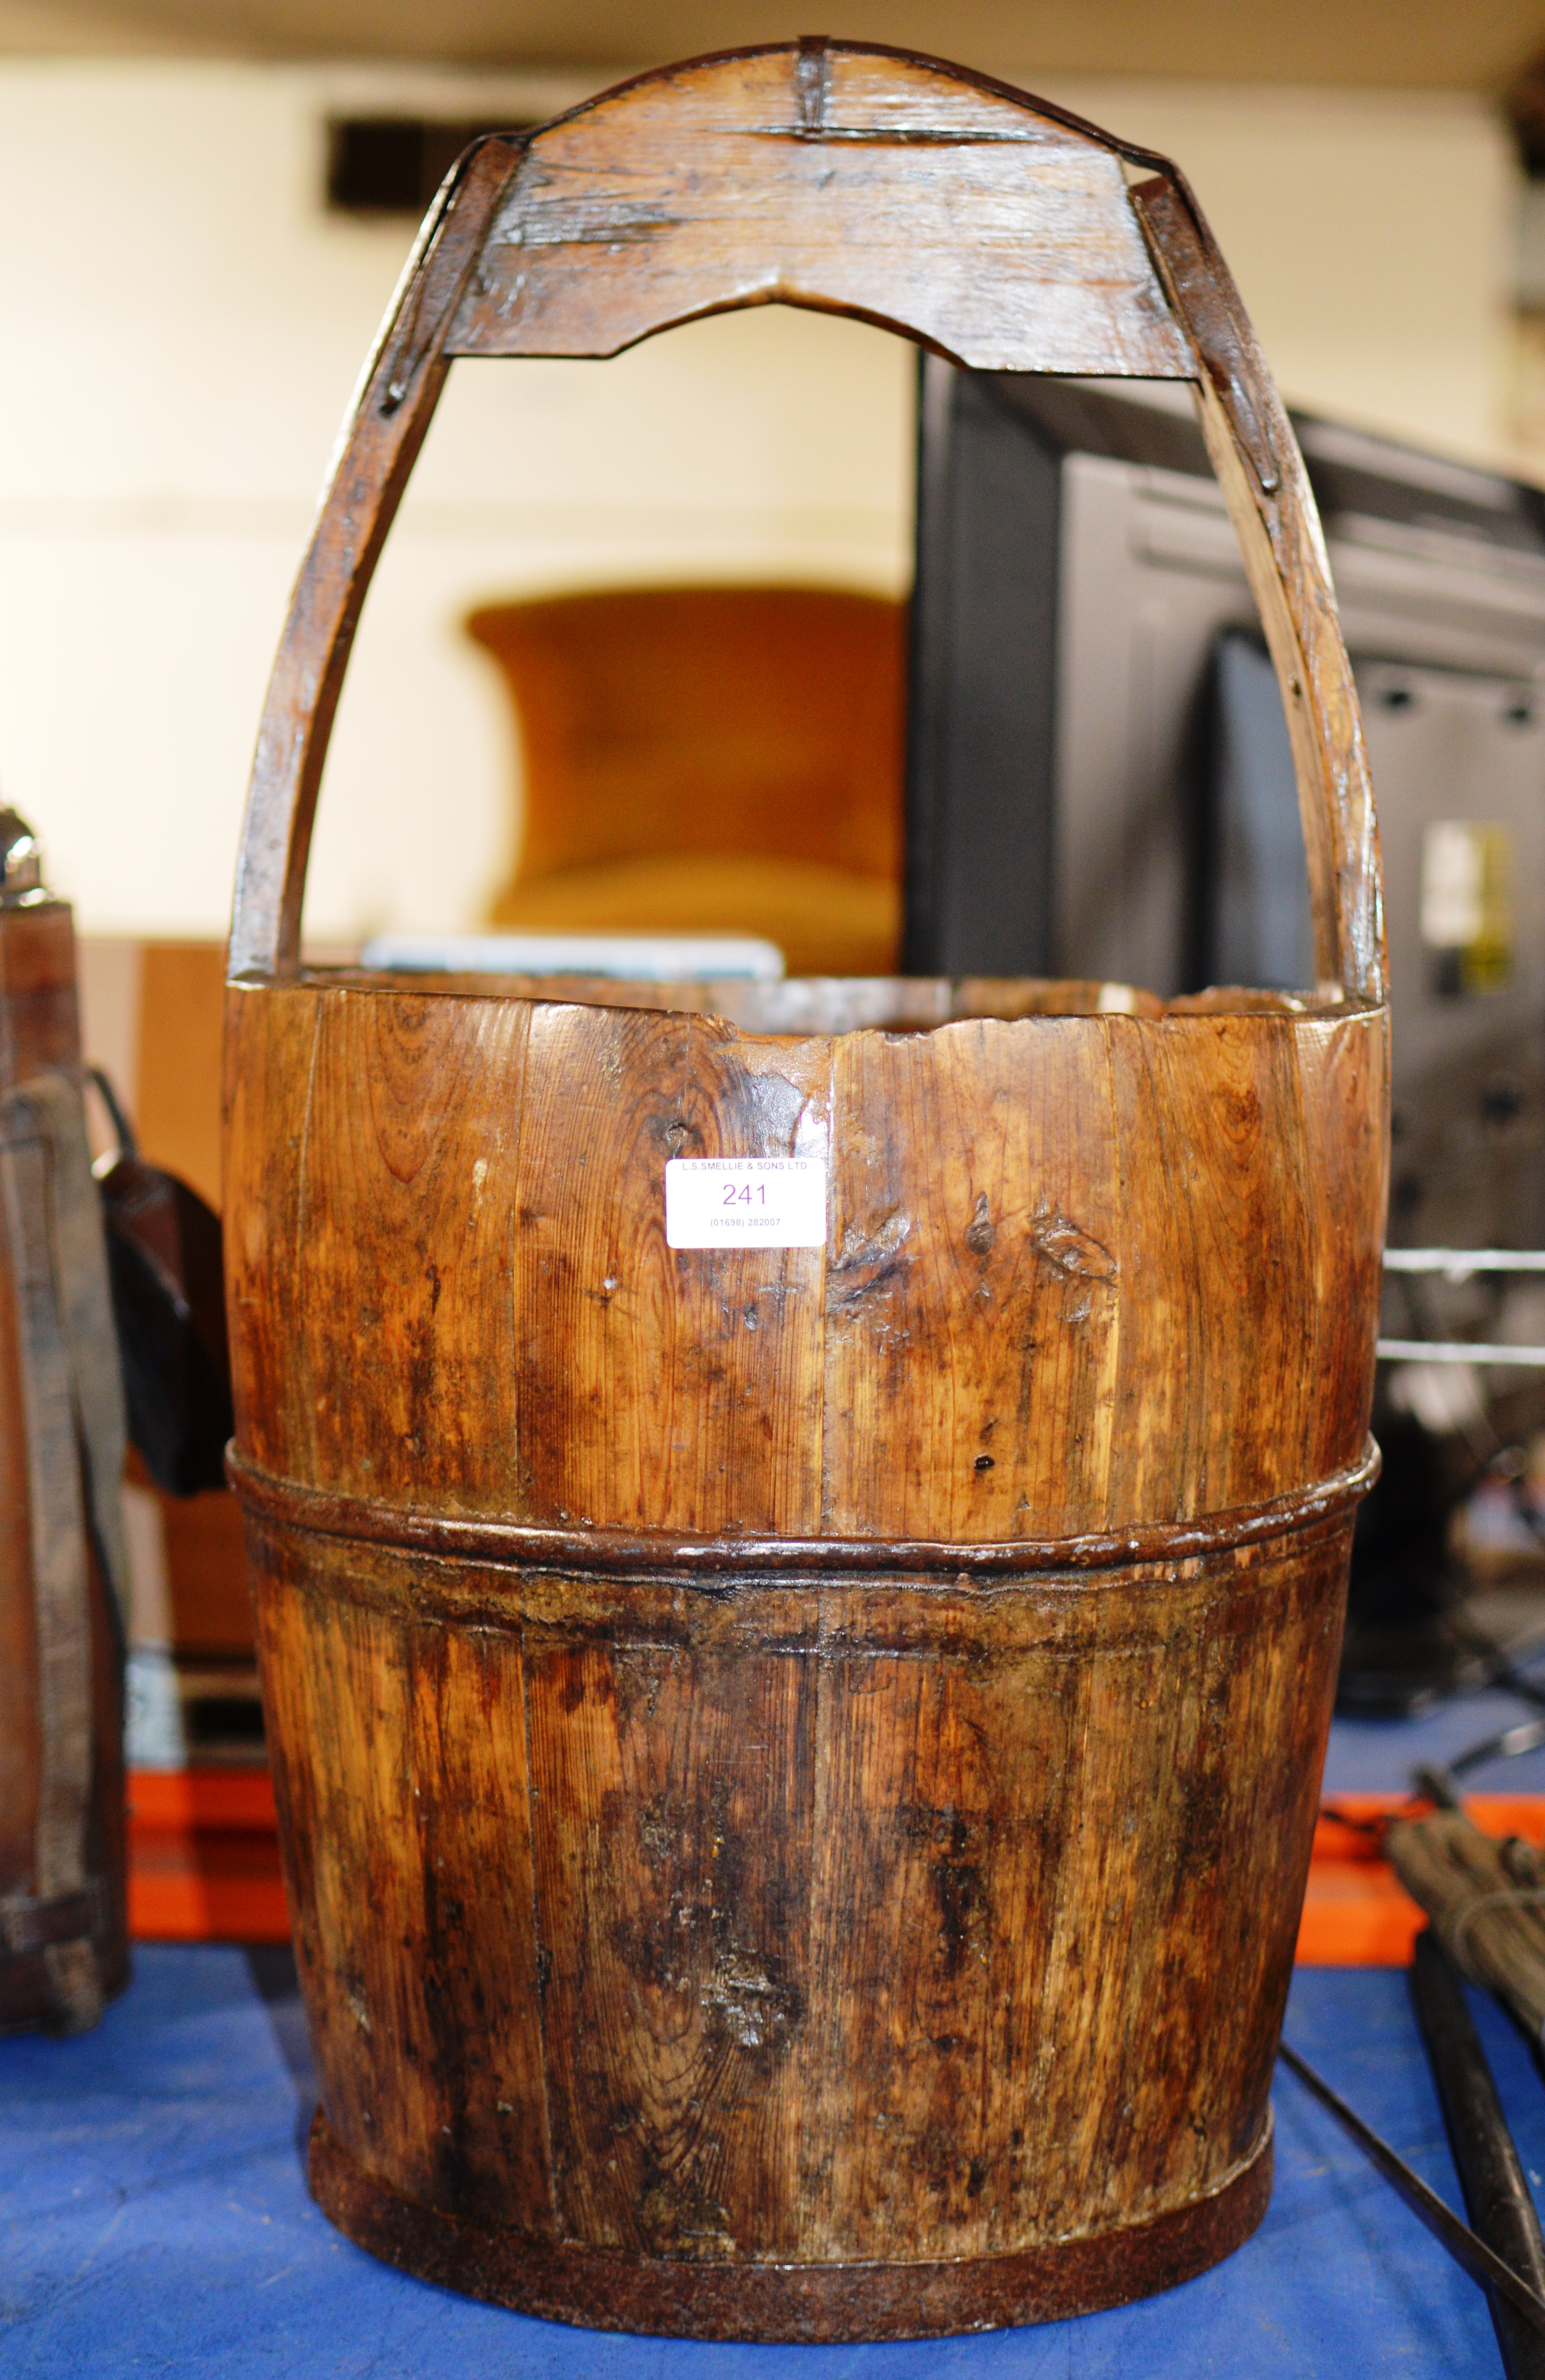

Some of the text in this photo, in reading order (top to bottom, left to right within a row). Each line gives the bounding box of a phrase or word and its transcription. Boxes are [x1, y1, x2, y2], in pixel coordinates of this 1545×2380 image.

[747, 1162, 753, 1170] &
[757, 1162, 785, 1170] SONS
[788, 1161, 808, 1170] LTD
[723, 1184, 765, 1205] 241
[710, 1218, 745, 1228] (01698)
